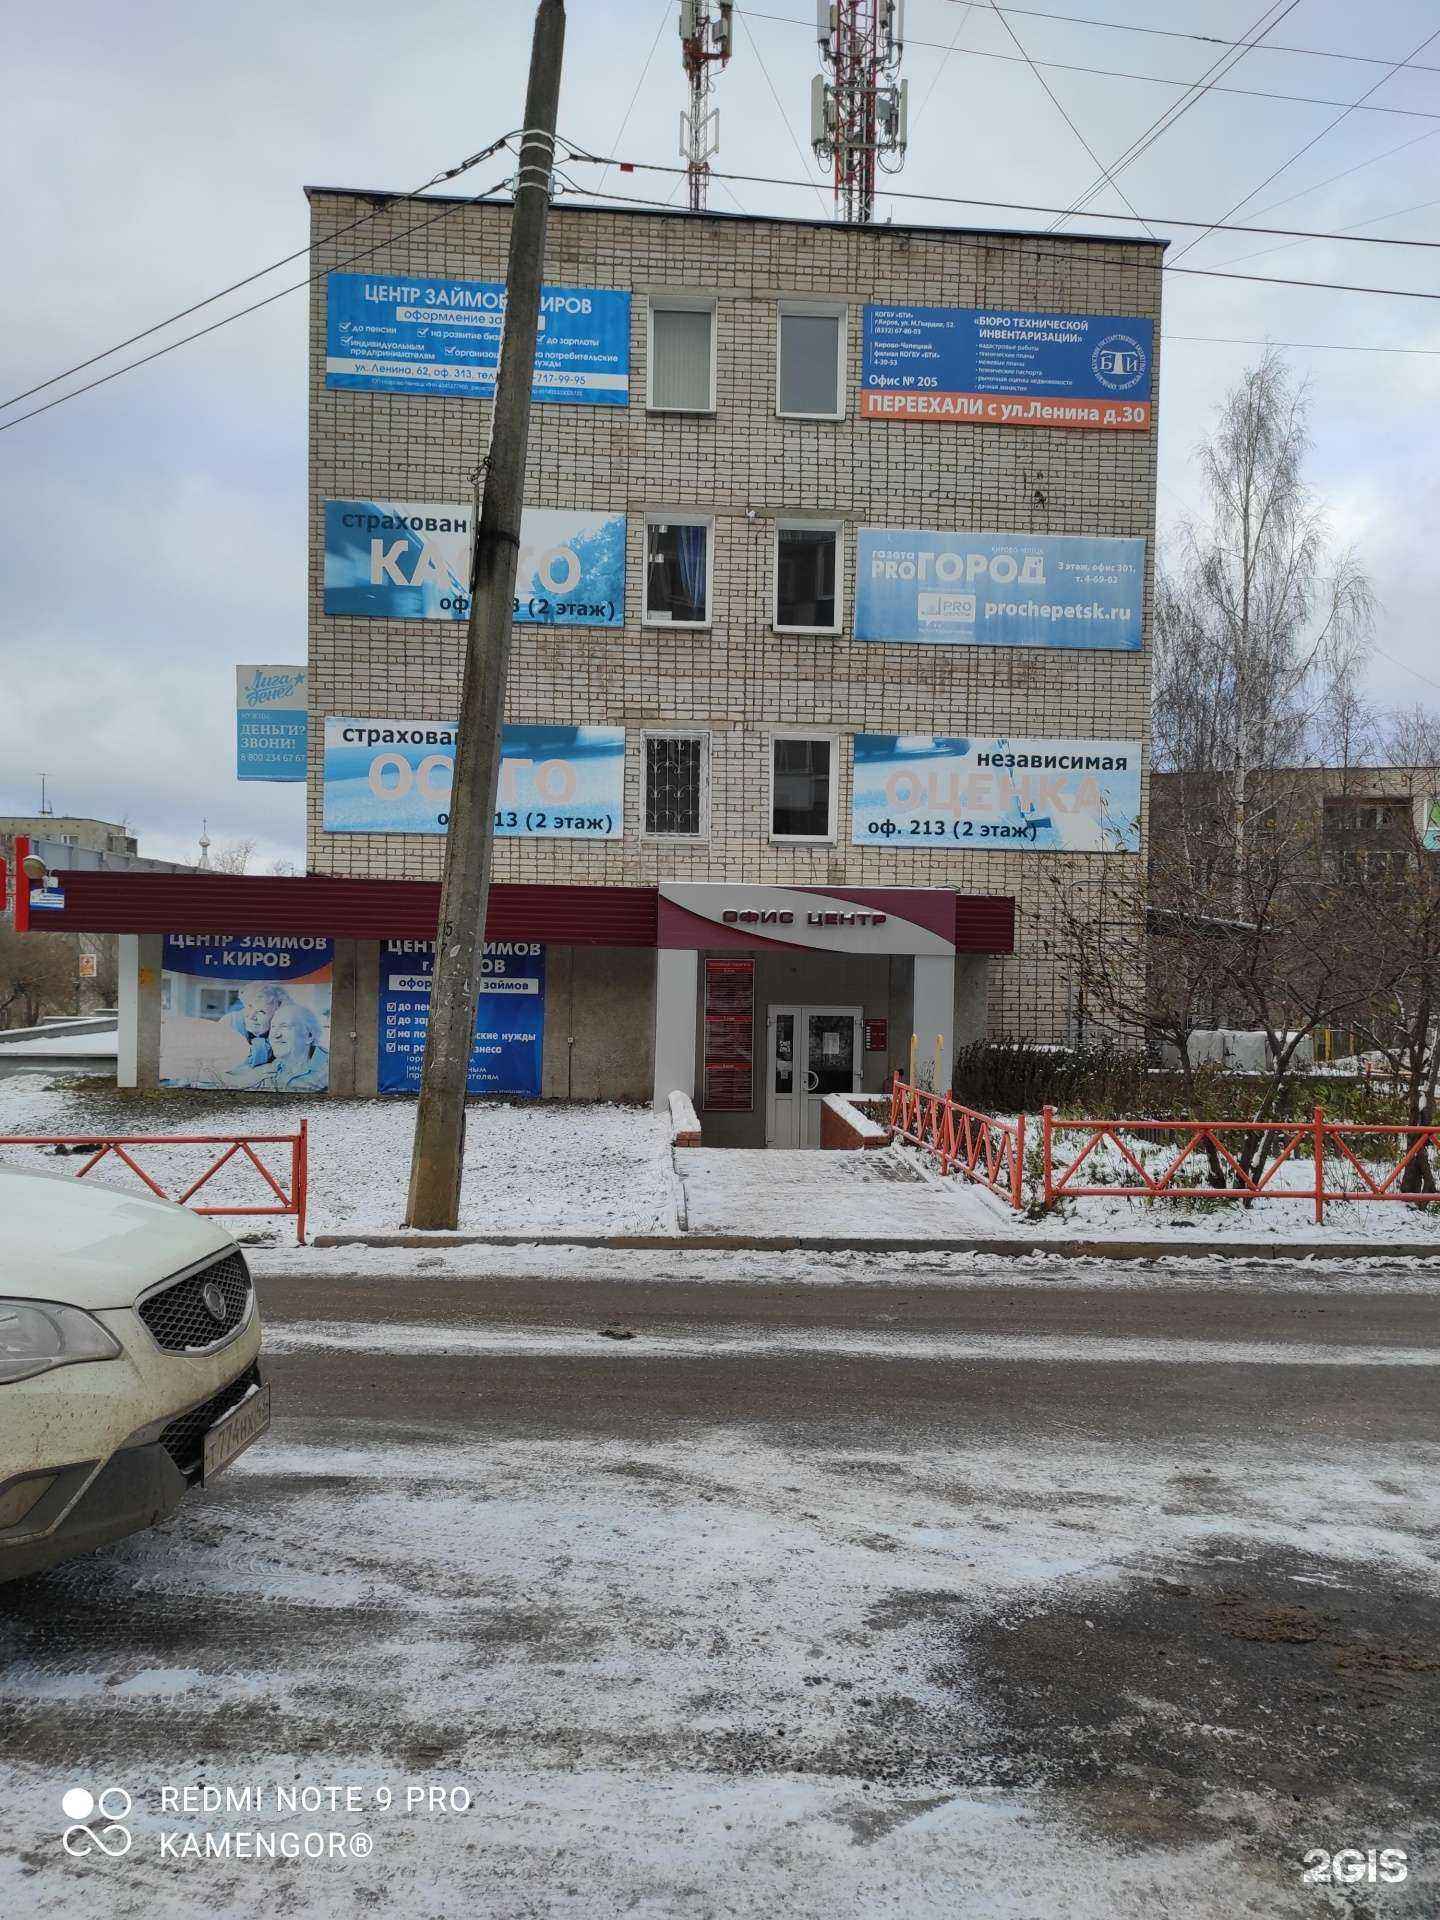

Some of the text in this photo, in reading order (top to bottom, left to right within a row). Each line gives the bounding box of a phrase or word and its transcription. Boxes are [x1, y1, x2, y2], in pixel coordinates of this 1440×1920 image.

[365, 284, 420, 304] ЦЕНТР
[540, 295, 592, 315] ИРОВ
[404, 309, 485, 325] оформление
[974, 316, 1089, 331] «БЮРО ТЕХНИЧЕСКОЙ
[352, 325, 397, 335] до пенсии
[431, 330, 443, 338] на
[443, 330, 482, 340] развитие
[979, 328, 1083, 344] ИНВЕНТАРИЗАЦИИ»
[350, 339, 425, 351] индивидуальным
[546, 337, 600, 347] до зарплаты
[350, 349, 436, 361] предпринимателям
[544, 351, 619, 362] потребительские
[355, 363, 369, 373] ул.
[371, 364, 414, 375] Ленина,
[416, 366, 430, 377] 62,
[433, 368, 450, 379] оф.
[869, 374, 938, 388] Офис № 205
[868, 394, 983, 415] ПЕРЕЕХАЛИ
[987, 402, 997, 417] с
[1103, 405, 1146, 424] д.30
[342, 512, 468, 533] страхован
[871, 550, 915, 560] газета
[369, 537, 582, 595] КАО
[1057, 561, 1064, 571] 3
[440, 595, 470, 616] оф
[529, 598, 549, 618] (2
[556, 601, 616, 621] этаж)
[984, 600, 1131, 621] prochepetsk.ru
[239, 724, 306, 736] ДЕНЬГИ?
[342, 727, 458, 747] страхова
[239, 737, 296, 749] ЗВОНИ!
[248, 753, 264, 762] 800
[977, 751, 1128, 771] независимая
[368, 752, 578, 806] ОСГО
[885, 770, 1101, 818] ОЦЕНКА
[494, 811, 613, 834] 13 (2 этаж)
[868, 818, 1038, 842] оф. 213 (2 этаж)
[722, 909, 887, 927] ОФИС ЦЕНТР
[169, 934, 233, 949] ЦЕНТР
[387, 939, 437, 956] ЦЕНТ
[205, 951, 292, 968] г. КИРОВ
[483, 980, 529, 991] займов
[397, 1003, 411, 1012] до
[397, 1017, 411, 1026] до
[397, 1031, 411, 1039] на
[501, 1033, 536, 1044] нужды
[397, 1044, 411, 1053] на
[473, 1045, 502, 1055] знеса
